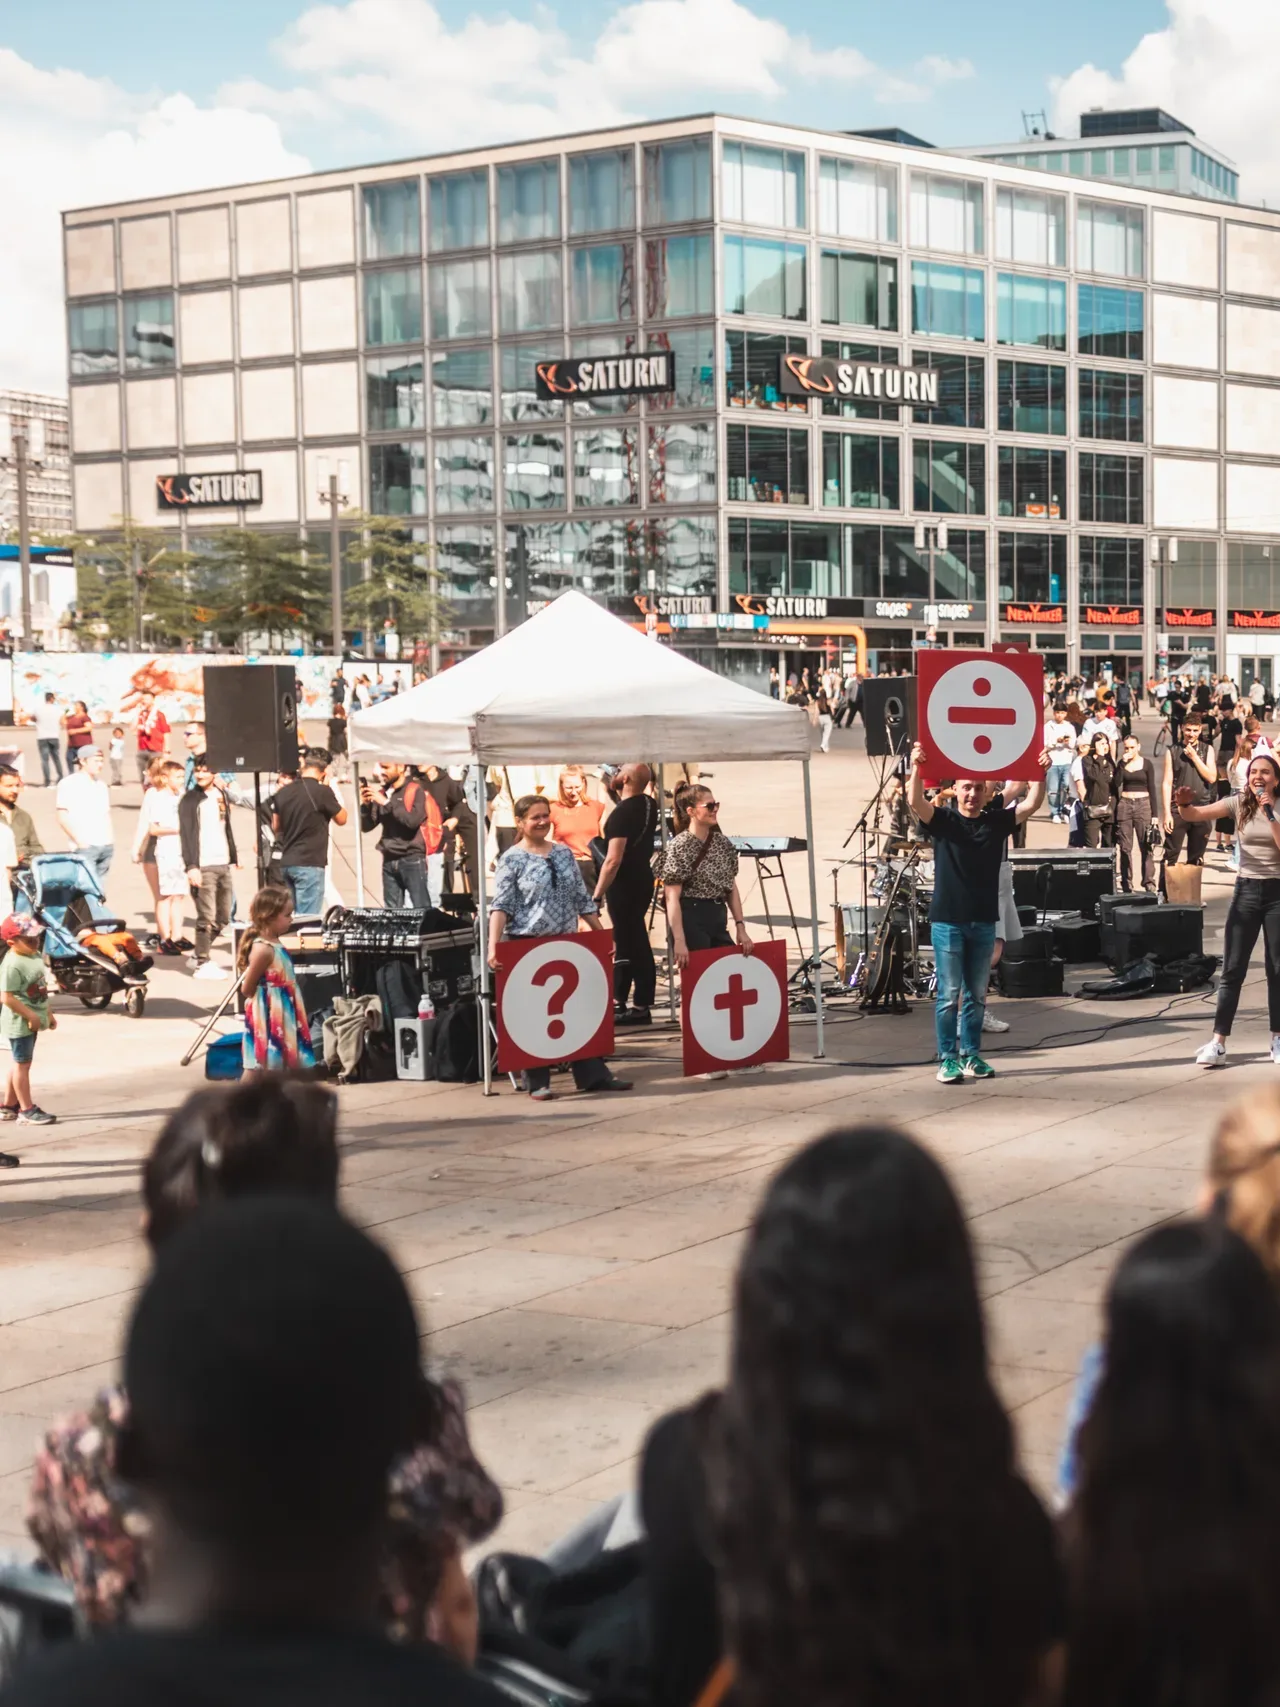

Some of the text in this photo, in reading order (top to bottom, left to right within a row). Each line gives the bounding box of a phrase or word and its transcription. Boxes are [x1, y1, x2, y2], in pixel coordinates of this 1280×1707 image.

[578, 355, 667, 392] SATURN
[837, 363, 938, 403] SATURN
[188, 474, 261, 503] SATURN
[658, 596, 712, 615] SATURN
[765, 597, 828, 617] SATURN
